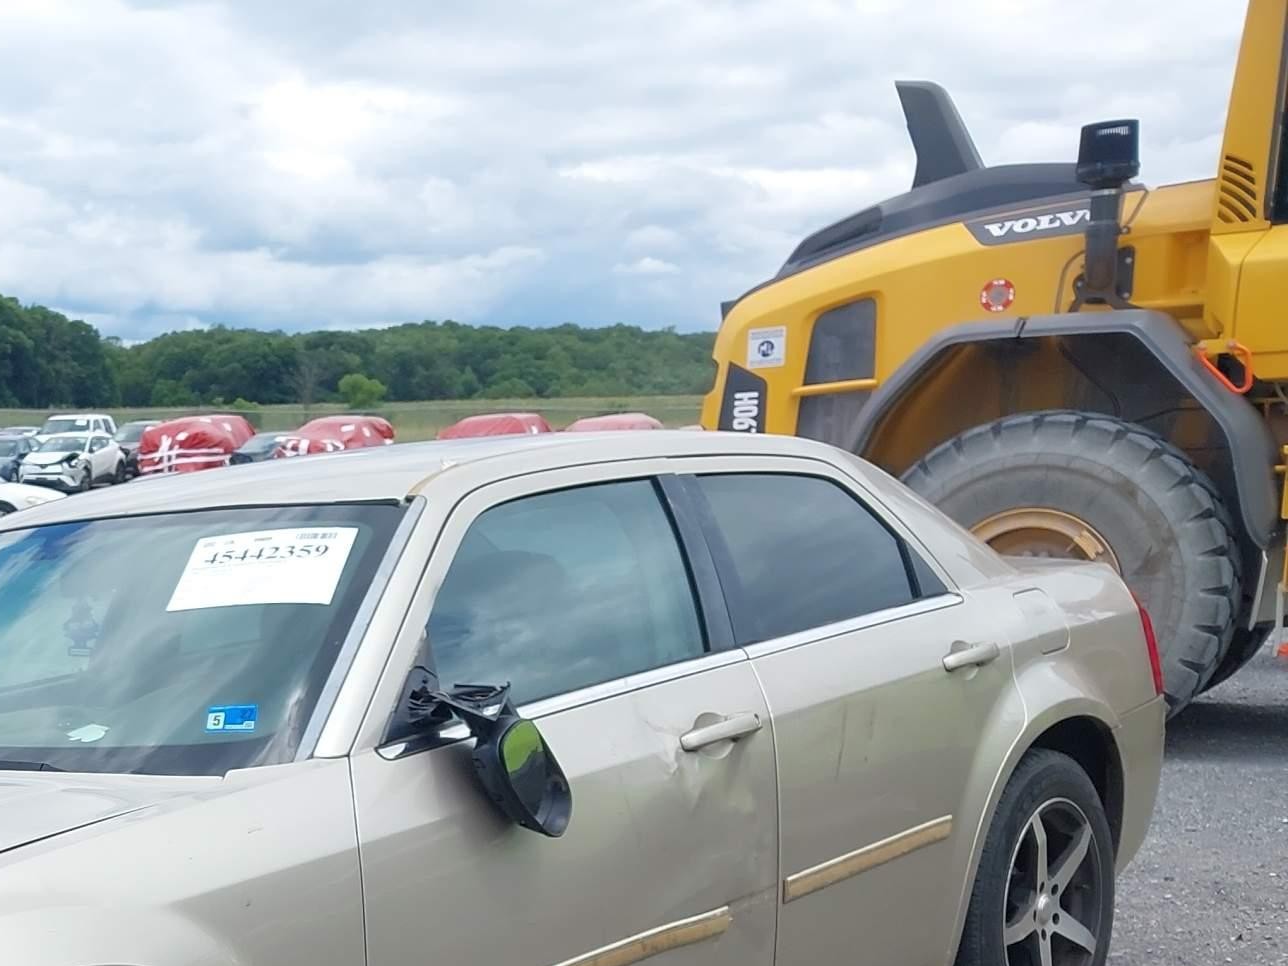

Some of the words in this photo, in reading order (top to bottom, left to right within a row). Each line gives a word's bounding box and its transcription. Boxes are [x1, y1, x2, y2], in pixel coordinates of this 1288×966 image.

[984, 209, 1091, 237] VOLV
[732, 391, 759, 434] 90H
[203, 544, 330, 565] 45442359
[212, 714, 222, 727] 5
